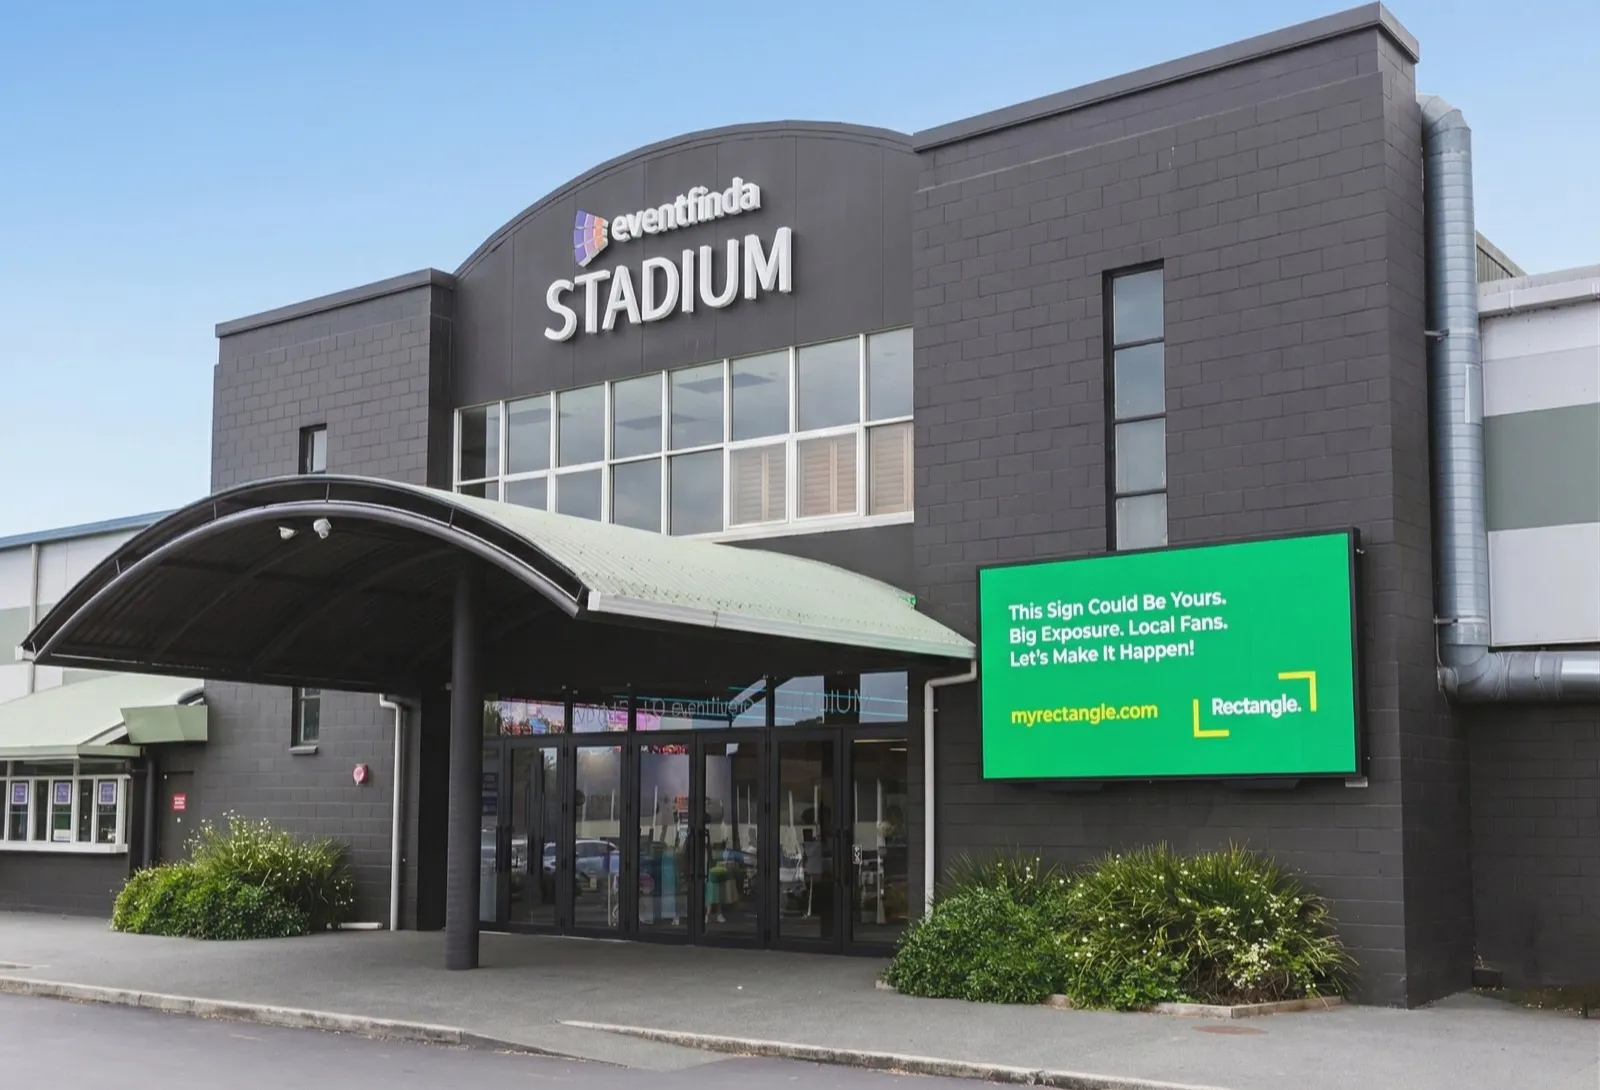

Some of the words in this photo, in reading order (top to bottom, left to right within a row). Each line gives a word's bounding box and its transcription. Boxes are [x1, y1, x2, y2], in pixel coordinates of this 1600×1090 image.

[612, 176, 761, 242] eventfinda
[545, 226, 792, 341] STADIUM
[1009, 602, 1042, 620] This
[1047, 599, 1083, 620] Sign
[1088, 595, 1138, 614] Could
[1143, 594, 1166, 610] Be
[1170, 590, 1227, 607] Yours.
[1009, 626, 1036, 646] Big
[1042, 620, 1124, 643] Exposure.
[1129, 617, 1175, 635] Local
[1180, 614, 1228, 632] Fans.
[1010, 649, 1048, 667] Let's
[1053, 646, 1098, 664] Make
[1103, 644, 1116, 661] It
[1120, 640, 1195, 662] Happen!
[1011, 702, 1158, 727] myrectangle.com
[1211, 693, 1302, 718] Rectangle.
